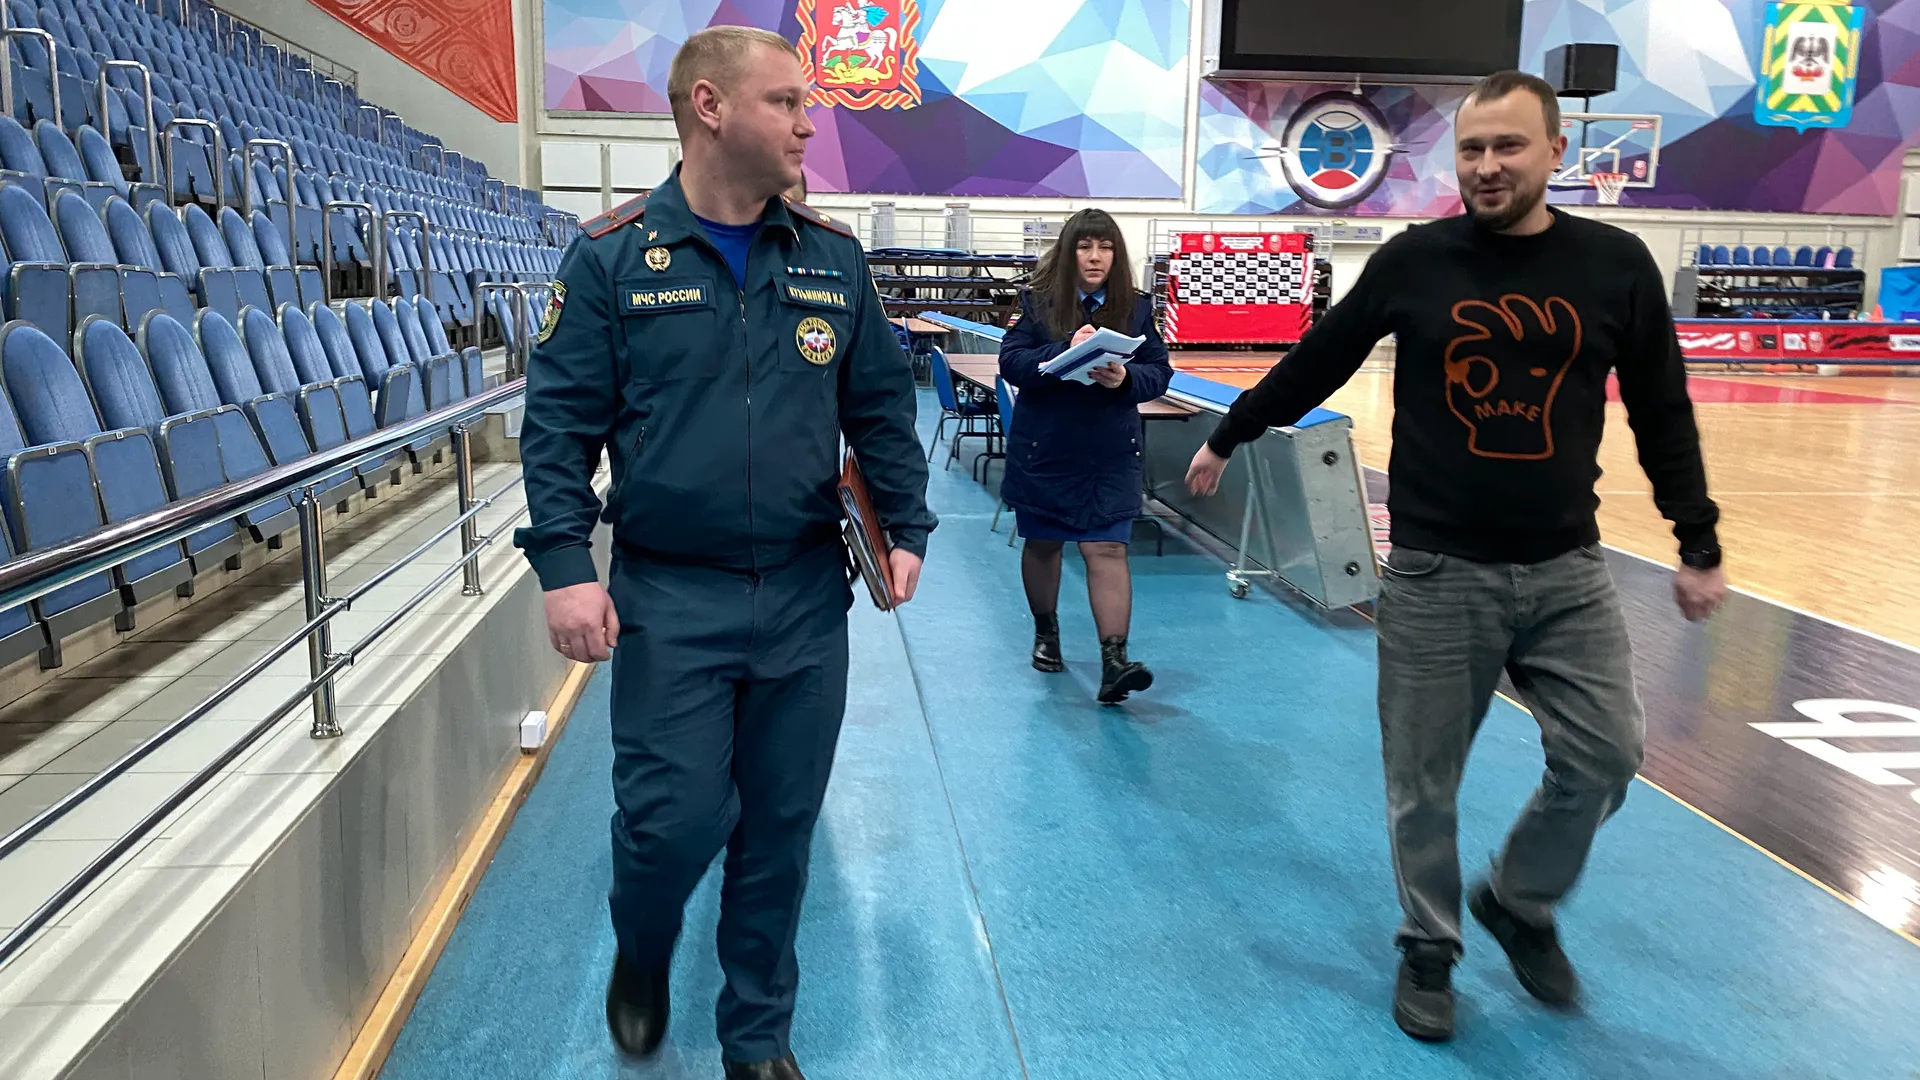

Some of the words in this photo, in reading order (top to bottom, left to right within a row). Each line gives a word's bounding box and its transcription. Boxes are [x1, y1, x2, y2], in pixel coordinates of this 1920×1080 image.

[631, 292, 656, 306] МЧС
[658, 287, 702, 305] РОССИИ
[1474, 399, 1541, 422] MAKE
